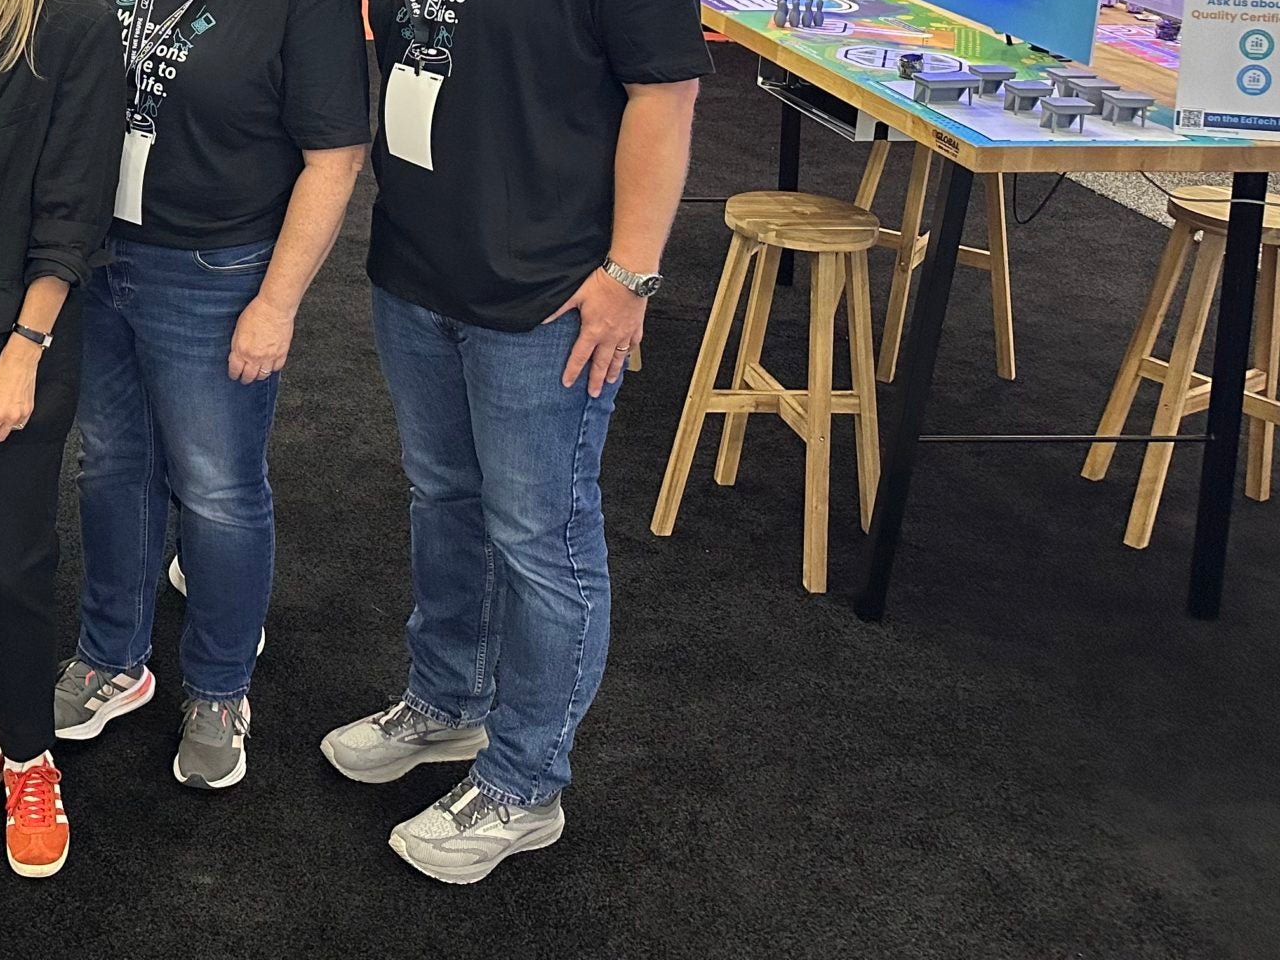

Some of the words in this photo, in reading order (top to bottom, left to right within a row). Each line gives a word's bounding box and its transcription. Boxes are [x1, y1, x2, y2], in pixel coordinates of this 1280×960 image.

[1233, 0, 1248, 7] us
[1191, 9, 1238, 23] Quality
[1240, 10, 1280, 23] Certifi
[158, 62, 177, 80] to
[140, 75, 168, 98] ife.
[1222, 115, 1239, 123] the
[1240, 116, 1276, 126] EdTech
